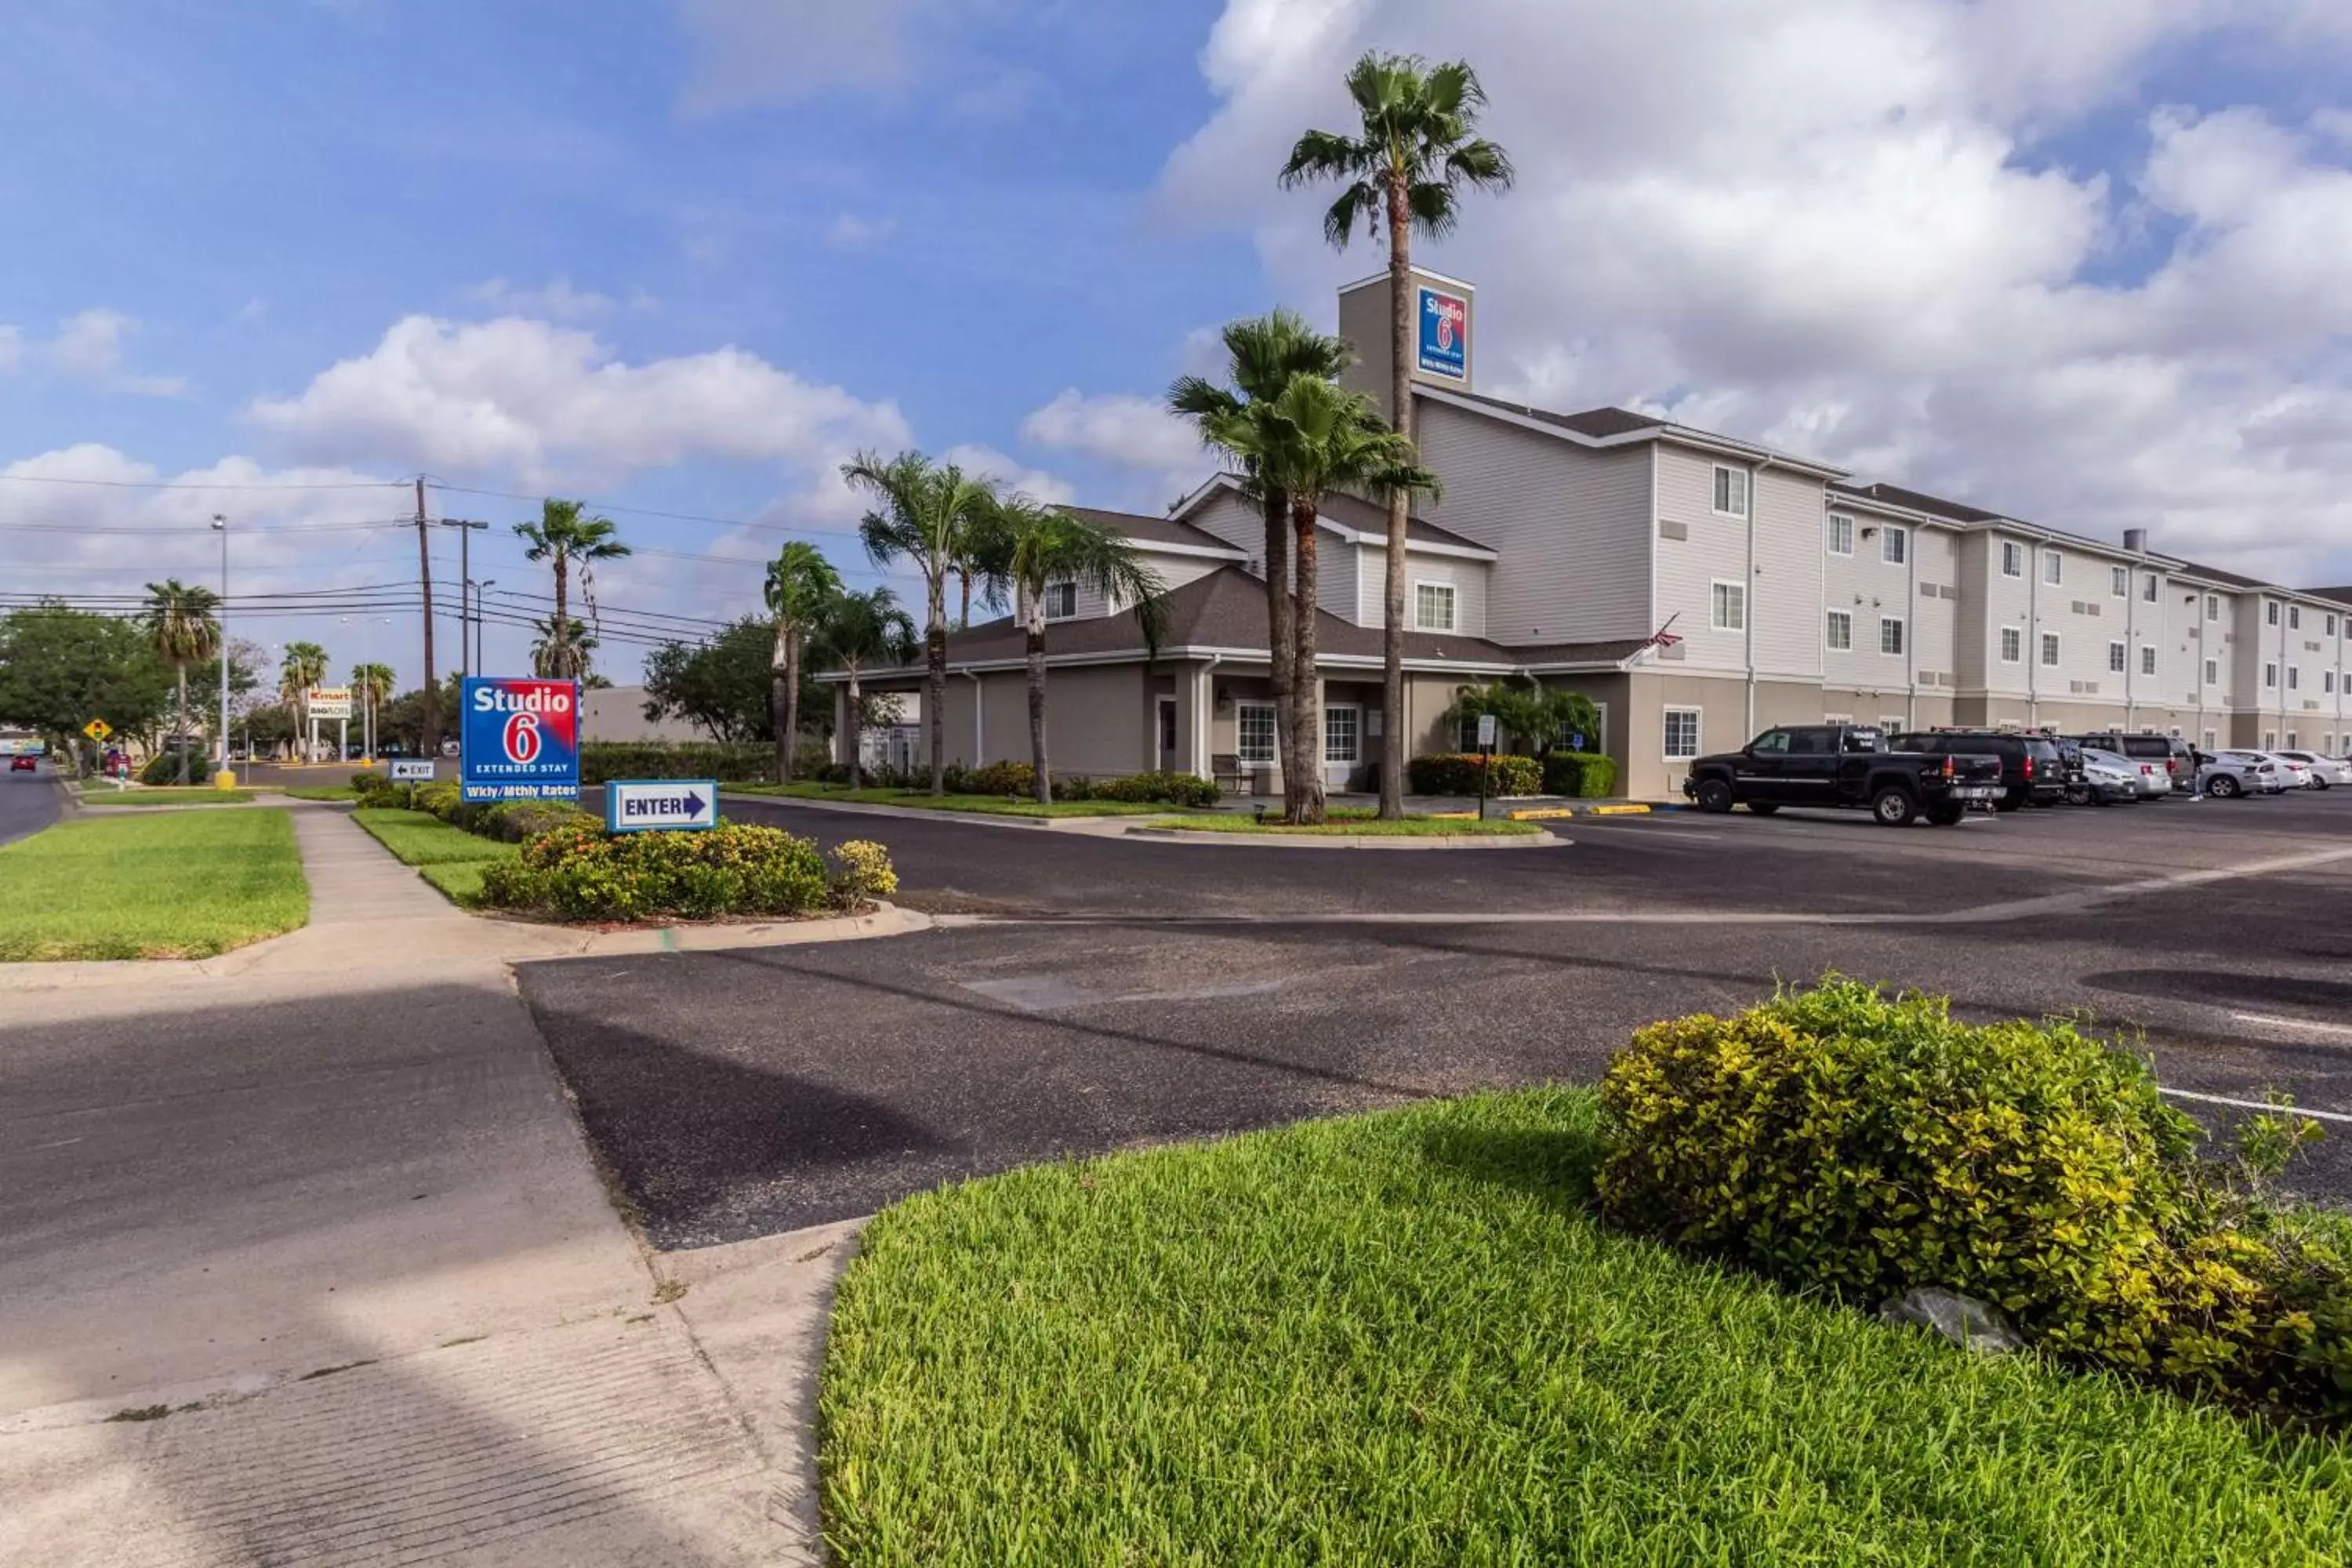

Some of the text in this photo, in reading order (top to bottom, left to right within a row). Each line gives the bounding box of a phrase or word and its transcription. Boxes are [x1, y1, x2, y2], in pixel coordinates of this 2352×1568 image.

[1425, 297, 1463, 321] Studio
[1437, 316, 1453, 350] 6
[310, 691, 350, 700] Kmart
[474, 687, 570, 713] Studio
[503, 711, 542, 764] 6
[410, 765, 430, 775] EXIT
[476, 764, 568, 774] EXTENDED STAY
[466, 785, 577, 799] Wkly/Mthly Rates
[625, 797, 681, 816] ENTER
